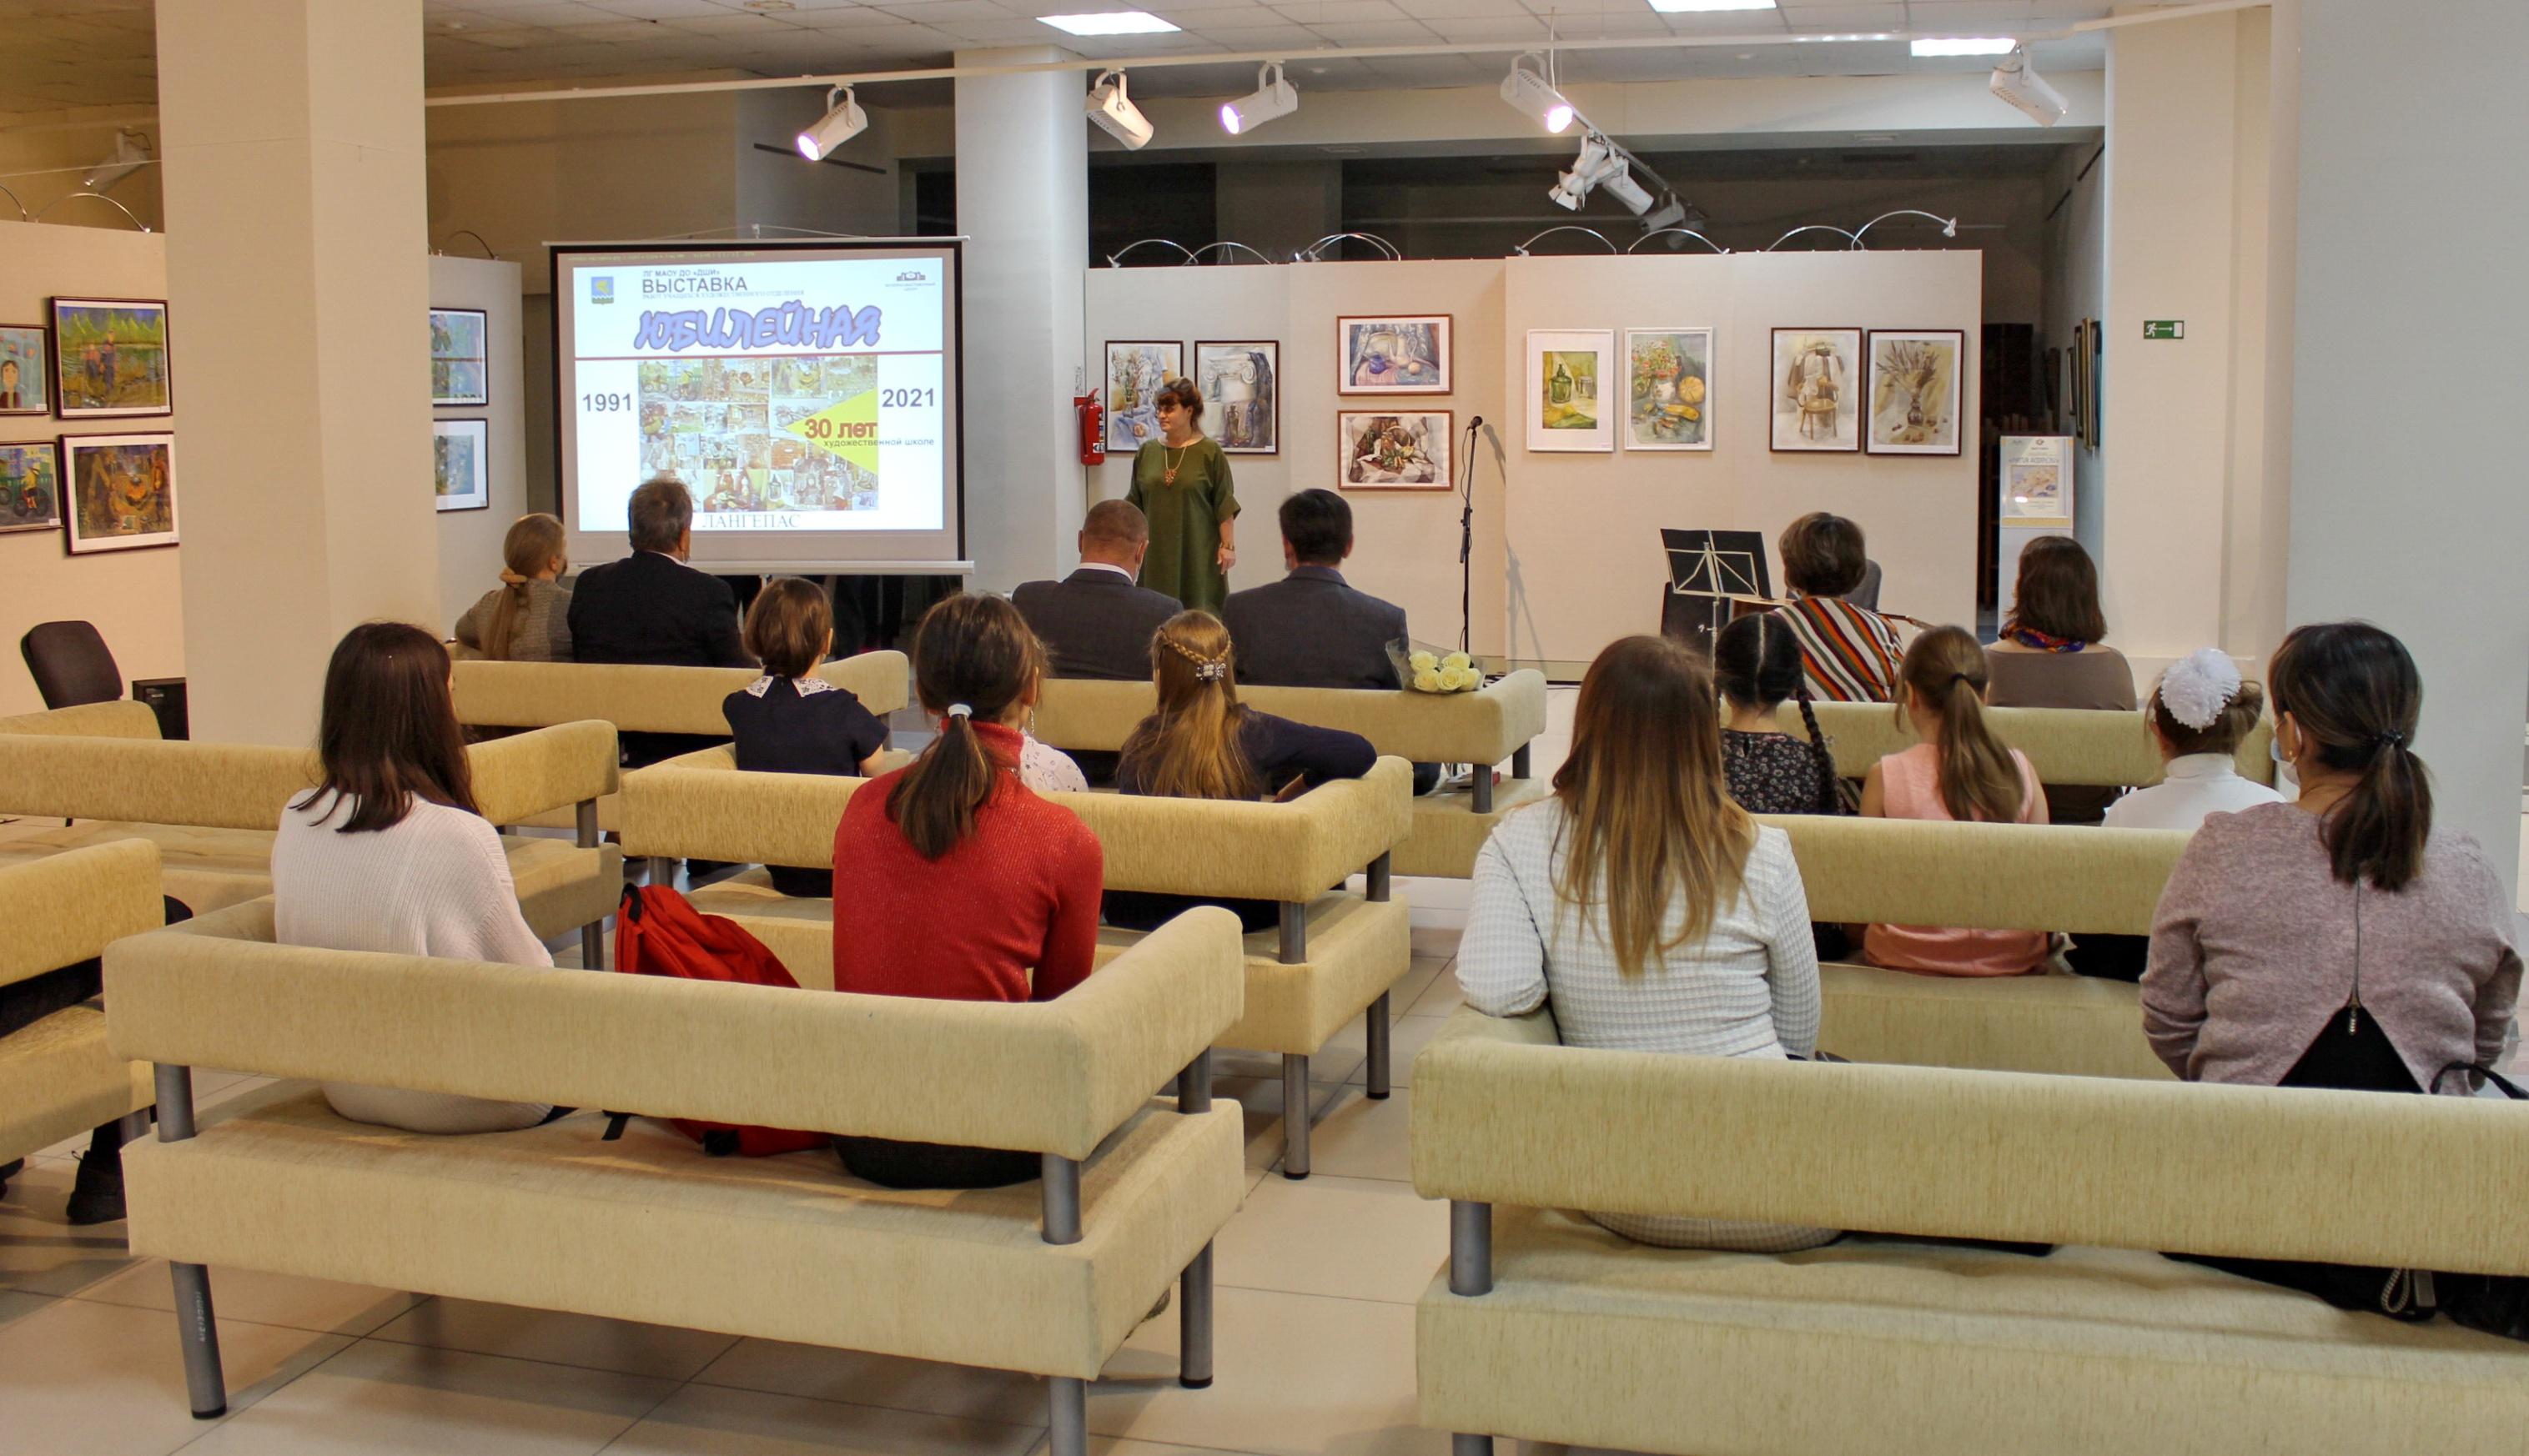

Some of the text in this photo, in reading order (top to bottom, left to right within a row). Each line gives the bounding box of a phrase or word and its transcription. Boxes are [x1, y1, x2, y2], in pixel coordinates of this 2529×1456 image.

[642, 277, 748, 294] ВЫСТАВКА
[634, 299, 882, 352] ЮБИЛЕЙНАЯ
[582, 393, 631, 412] 1991
[882, 388, 934, 408] 2021
[804, 418, 878, 439] 30 лет
[824, 438, 935, 448] художественной школе
[701, 514, 801, 528] ЛАНГЕПАС
